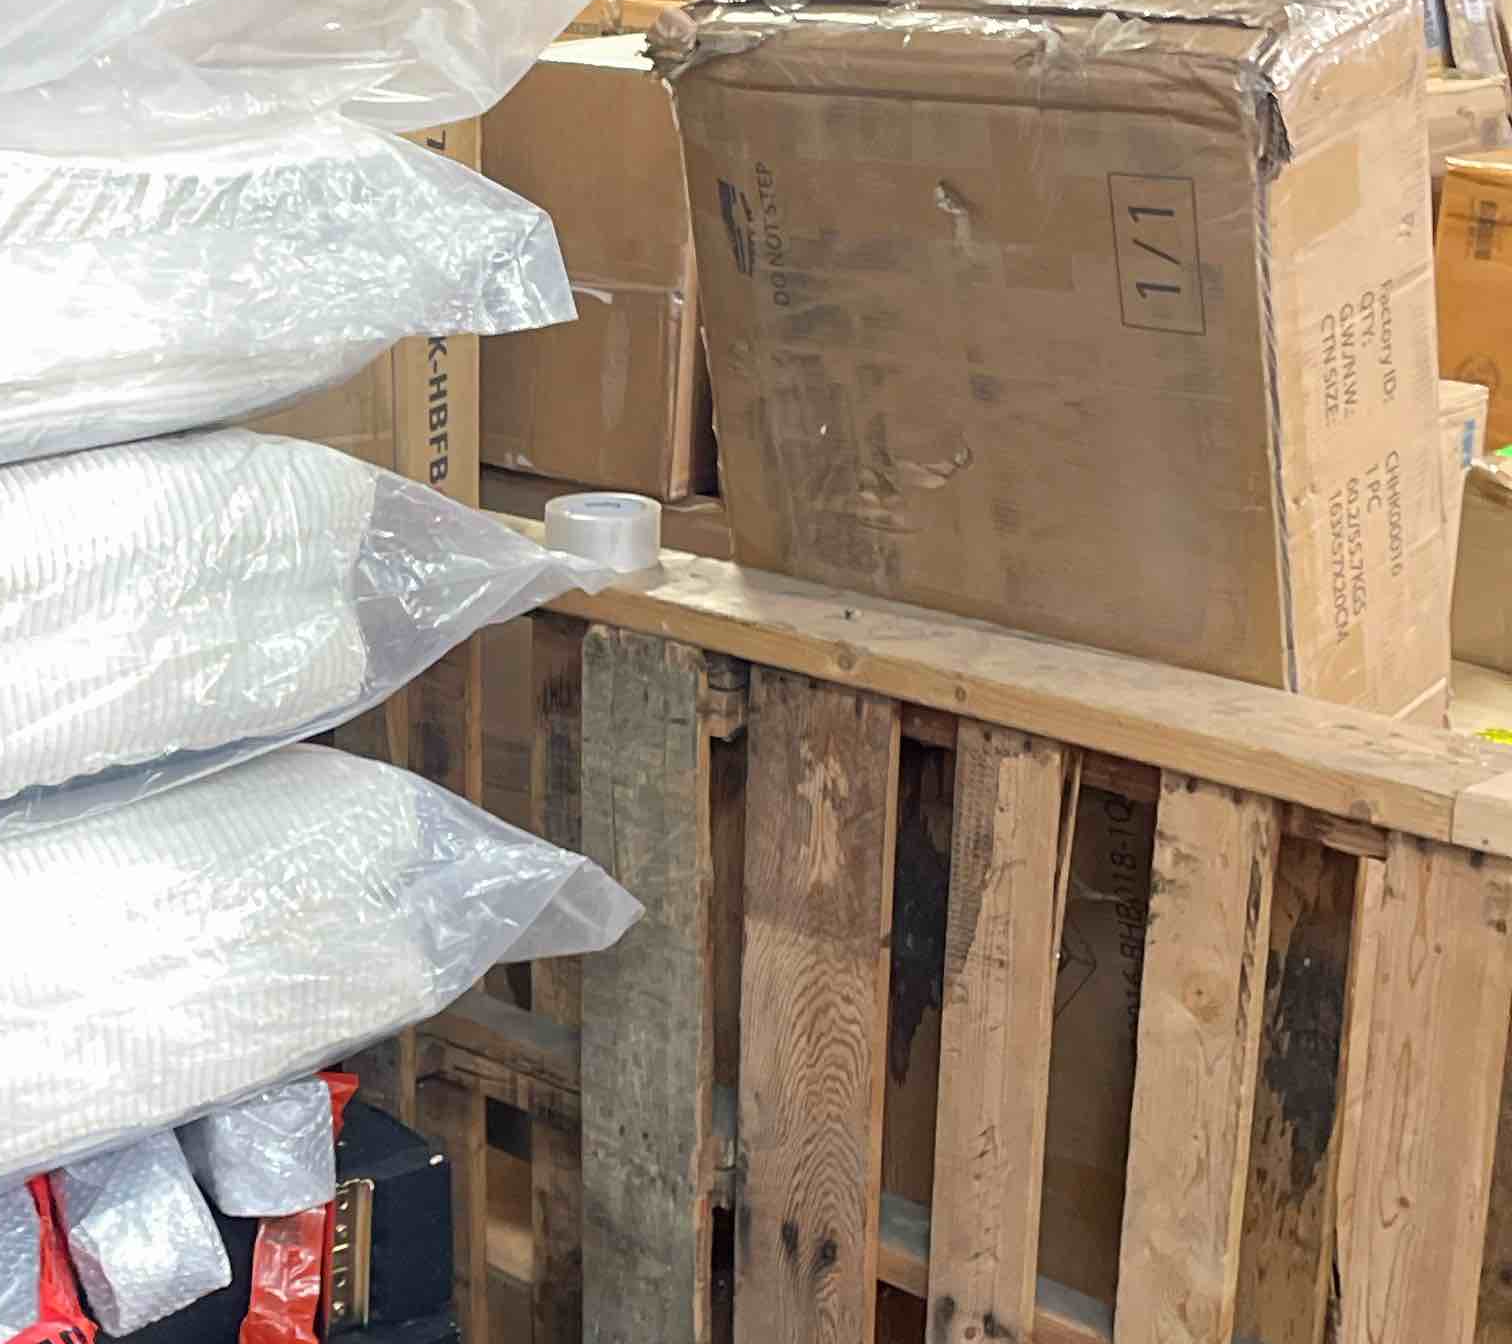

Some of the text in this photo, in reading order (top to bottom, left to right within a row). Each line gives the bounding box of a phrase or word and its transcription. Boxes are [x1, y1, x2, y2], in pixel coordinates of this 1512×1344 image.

[756, 160, 777, 215] STEP
[764, 217, 784, 267] NOT
[1367, 481, 1383, 514] PC
